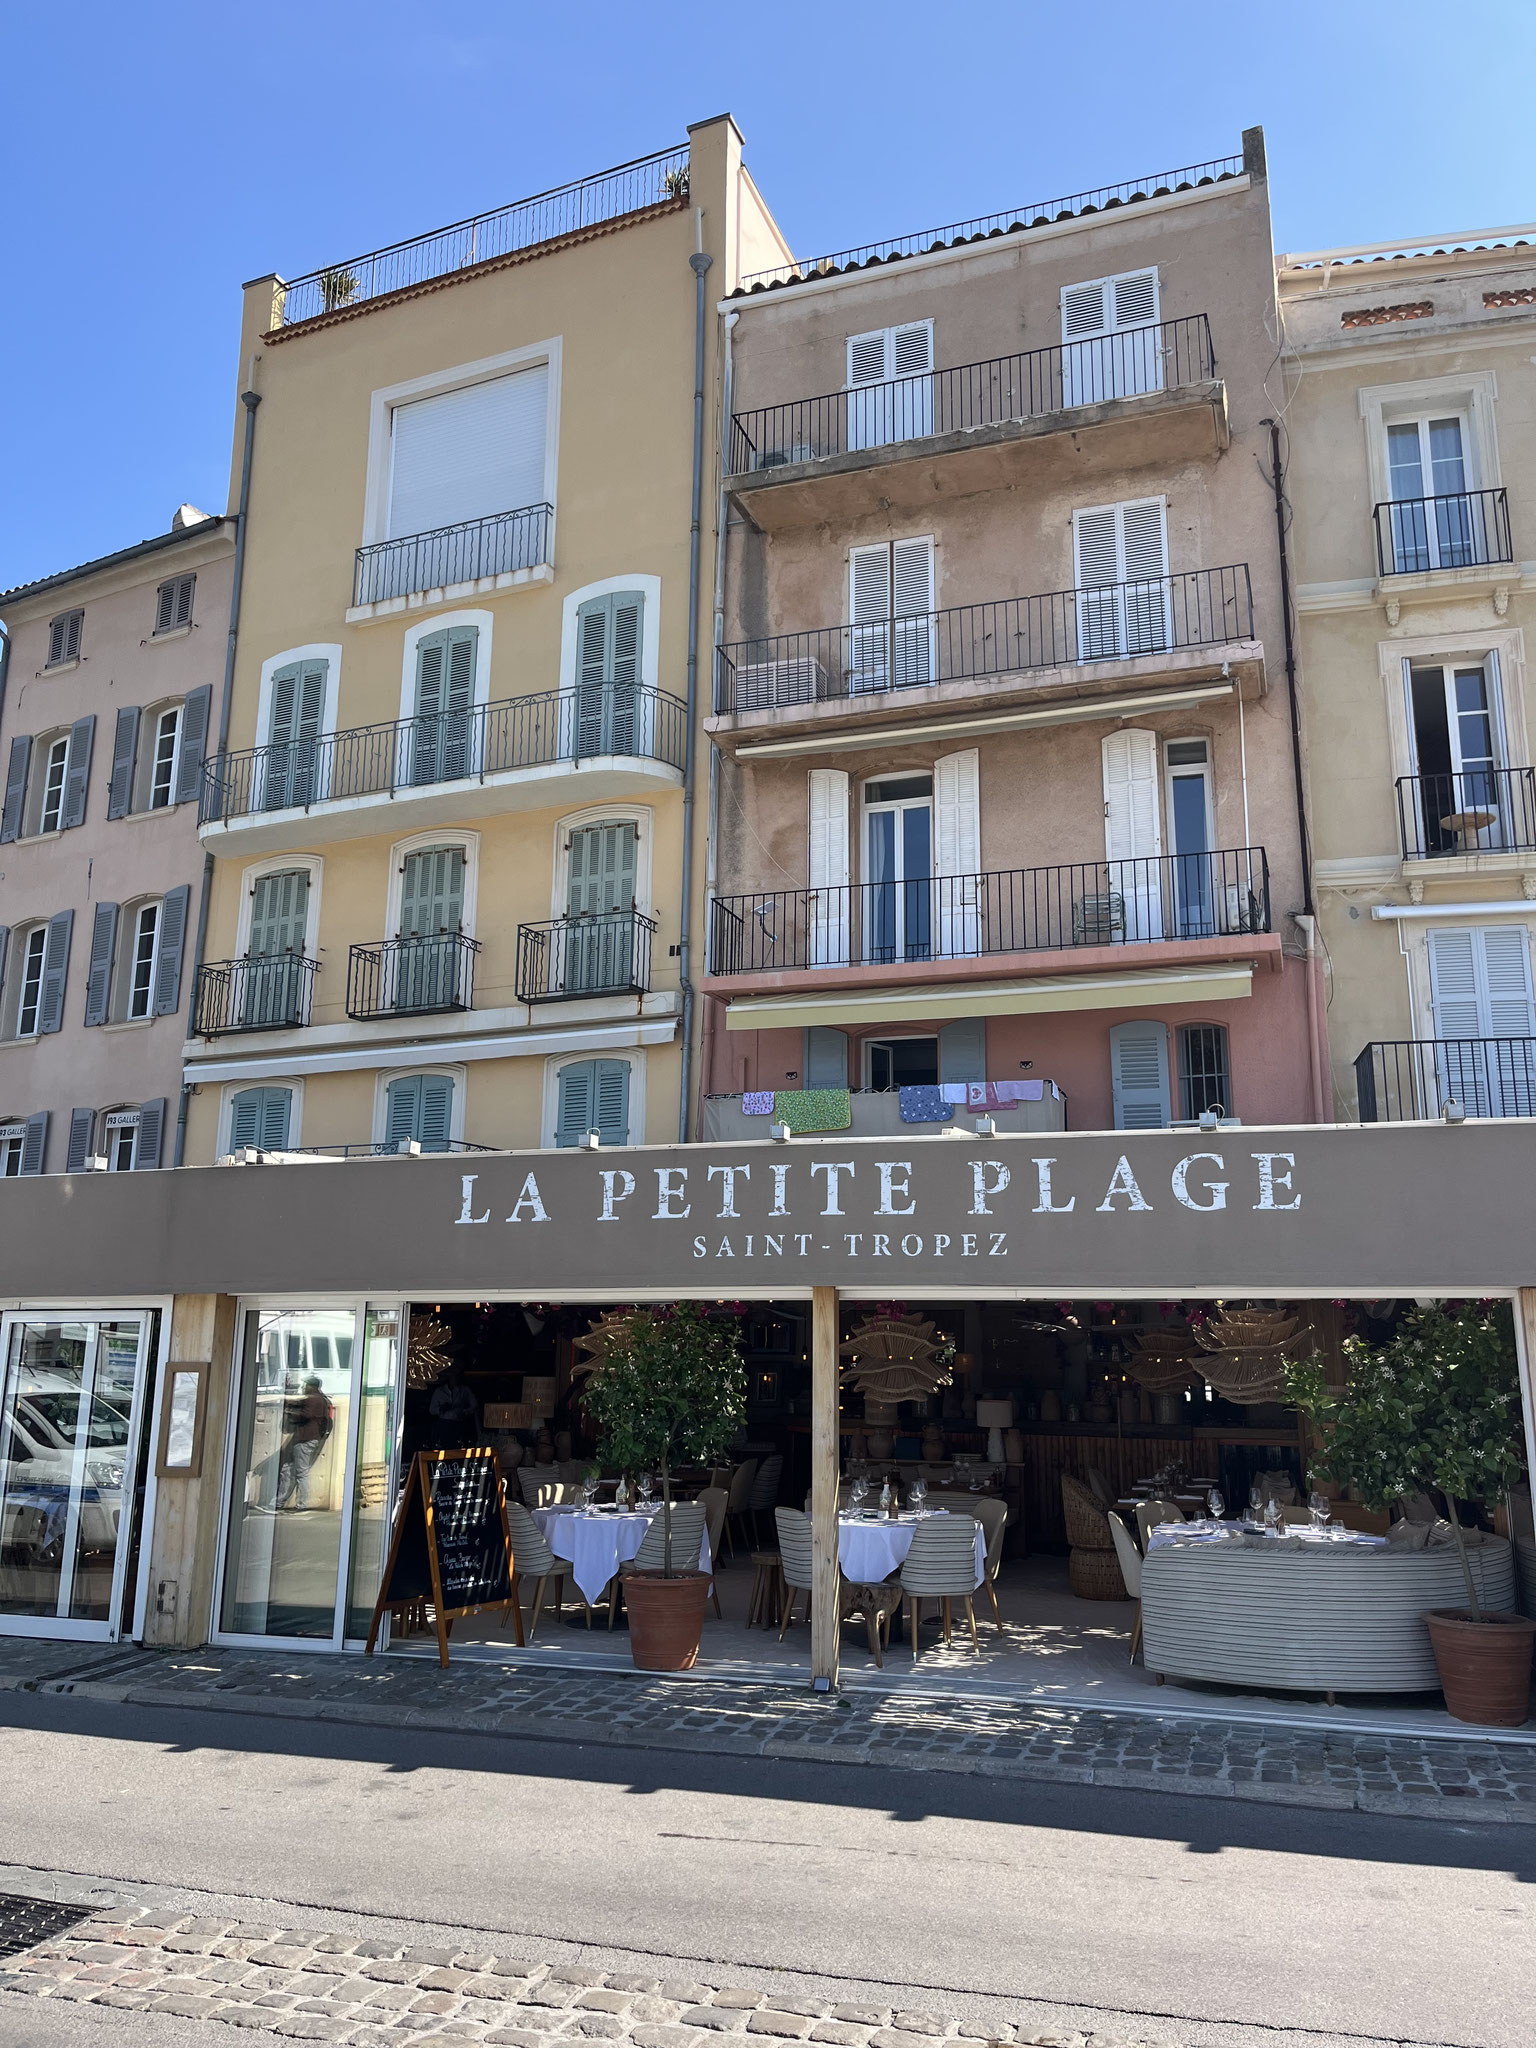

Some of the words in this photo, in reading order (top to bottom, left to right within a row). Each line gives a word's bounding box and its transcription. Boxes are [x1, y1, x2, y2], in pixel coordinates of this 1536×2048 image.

[107, 1116, 117, 1125] 193
[117, 1115, 140, 1124] GALLER
[454, 1171, 552, 1224] LA
[596, 1161, 917, 1221] PETITE
[967, 1153, 1302, 1215] PLAGE
